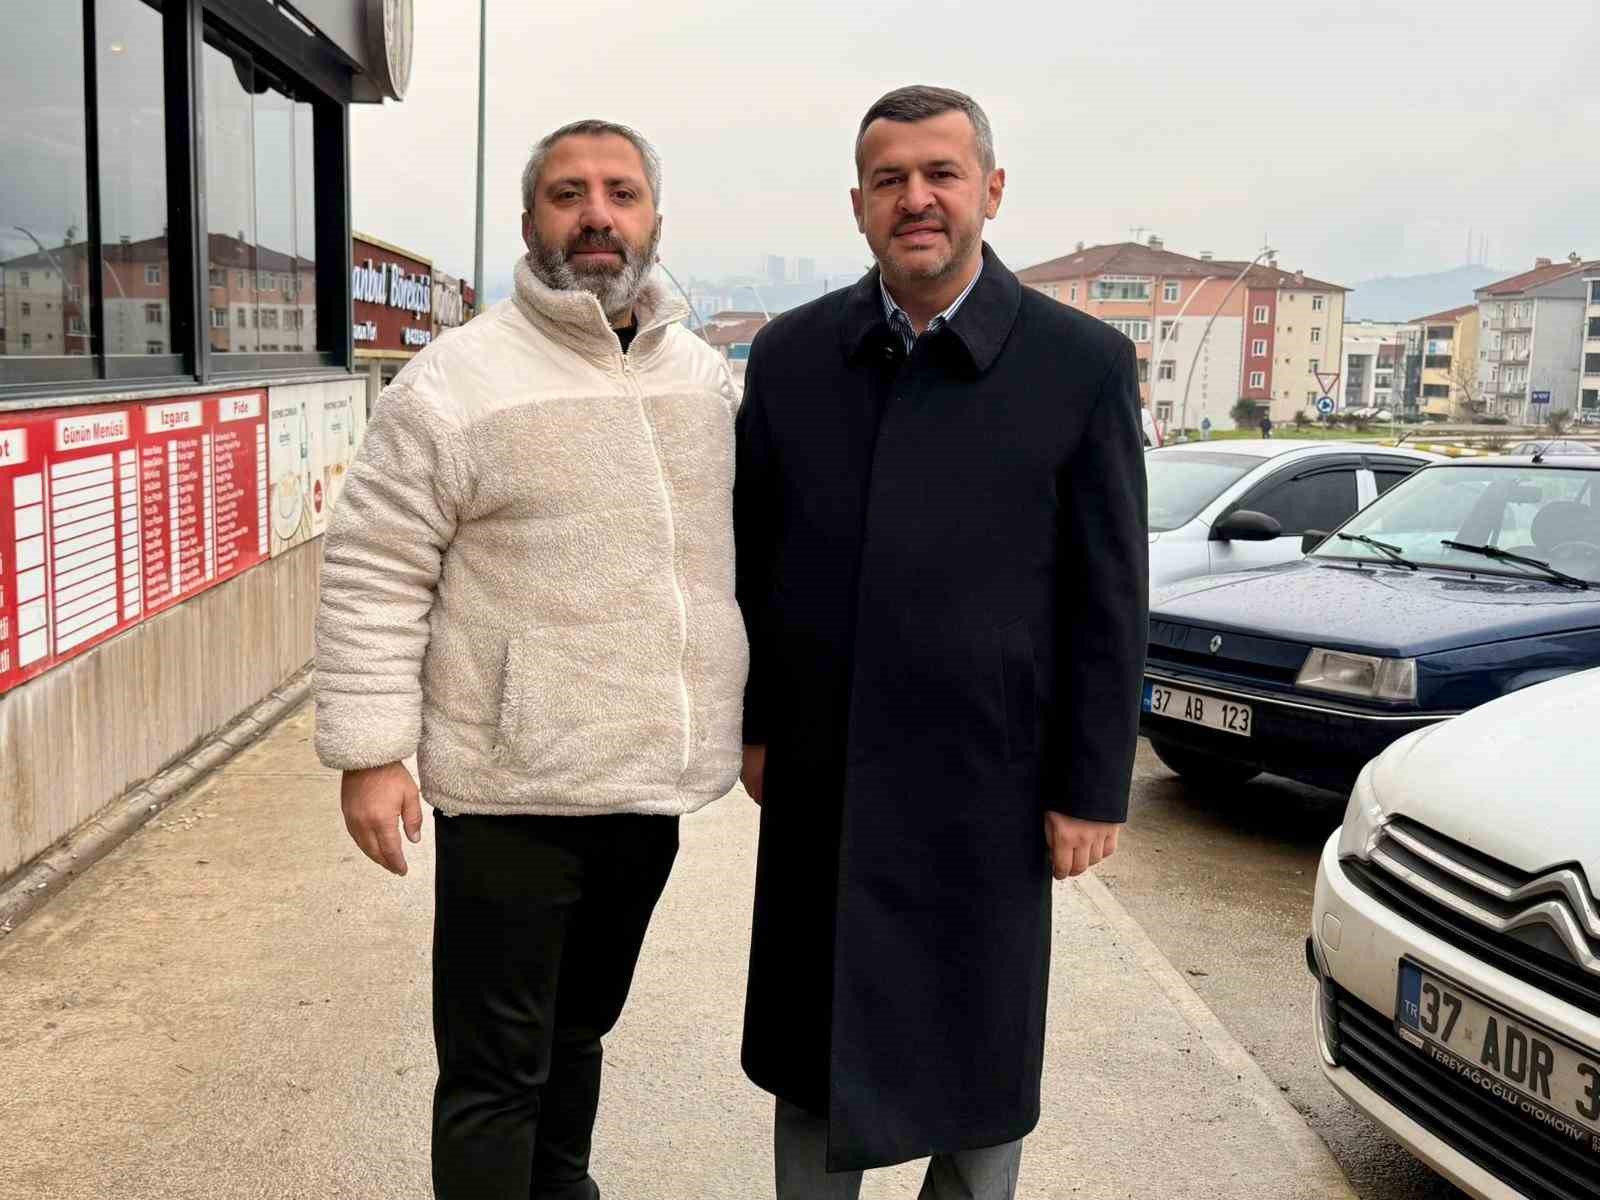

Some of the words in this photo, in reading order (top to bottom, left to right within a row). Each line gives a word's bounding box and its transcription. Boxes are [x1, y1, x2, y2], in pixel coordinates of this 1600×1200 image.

[63, 424, 91, 445] Günün
[93, 418, 124, 440] Menüsü
[1153, 689, 1172, 712] 37
[1184, 696, 1204, 721] AB
[1222, 704, 1250, 731] 123
[1404, 999, 1418, 1019] TR
[1420, 982, 1463, 1043] 37
[1480, 1016, 1554, 1100] ADR
